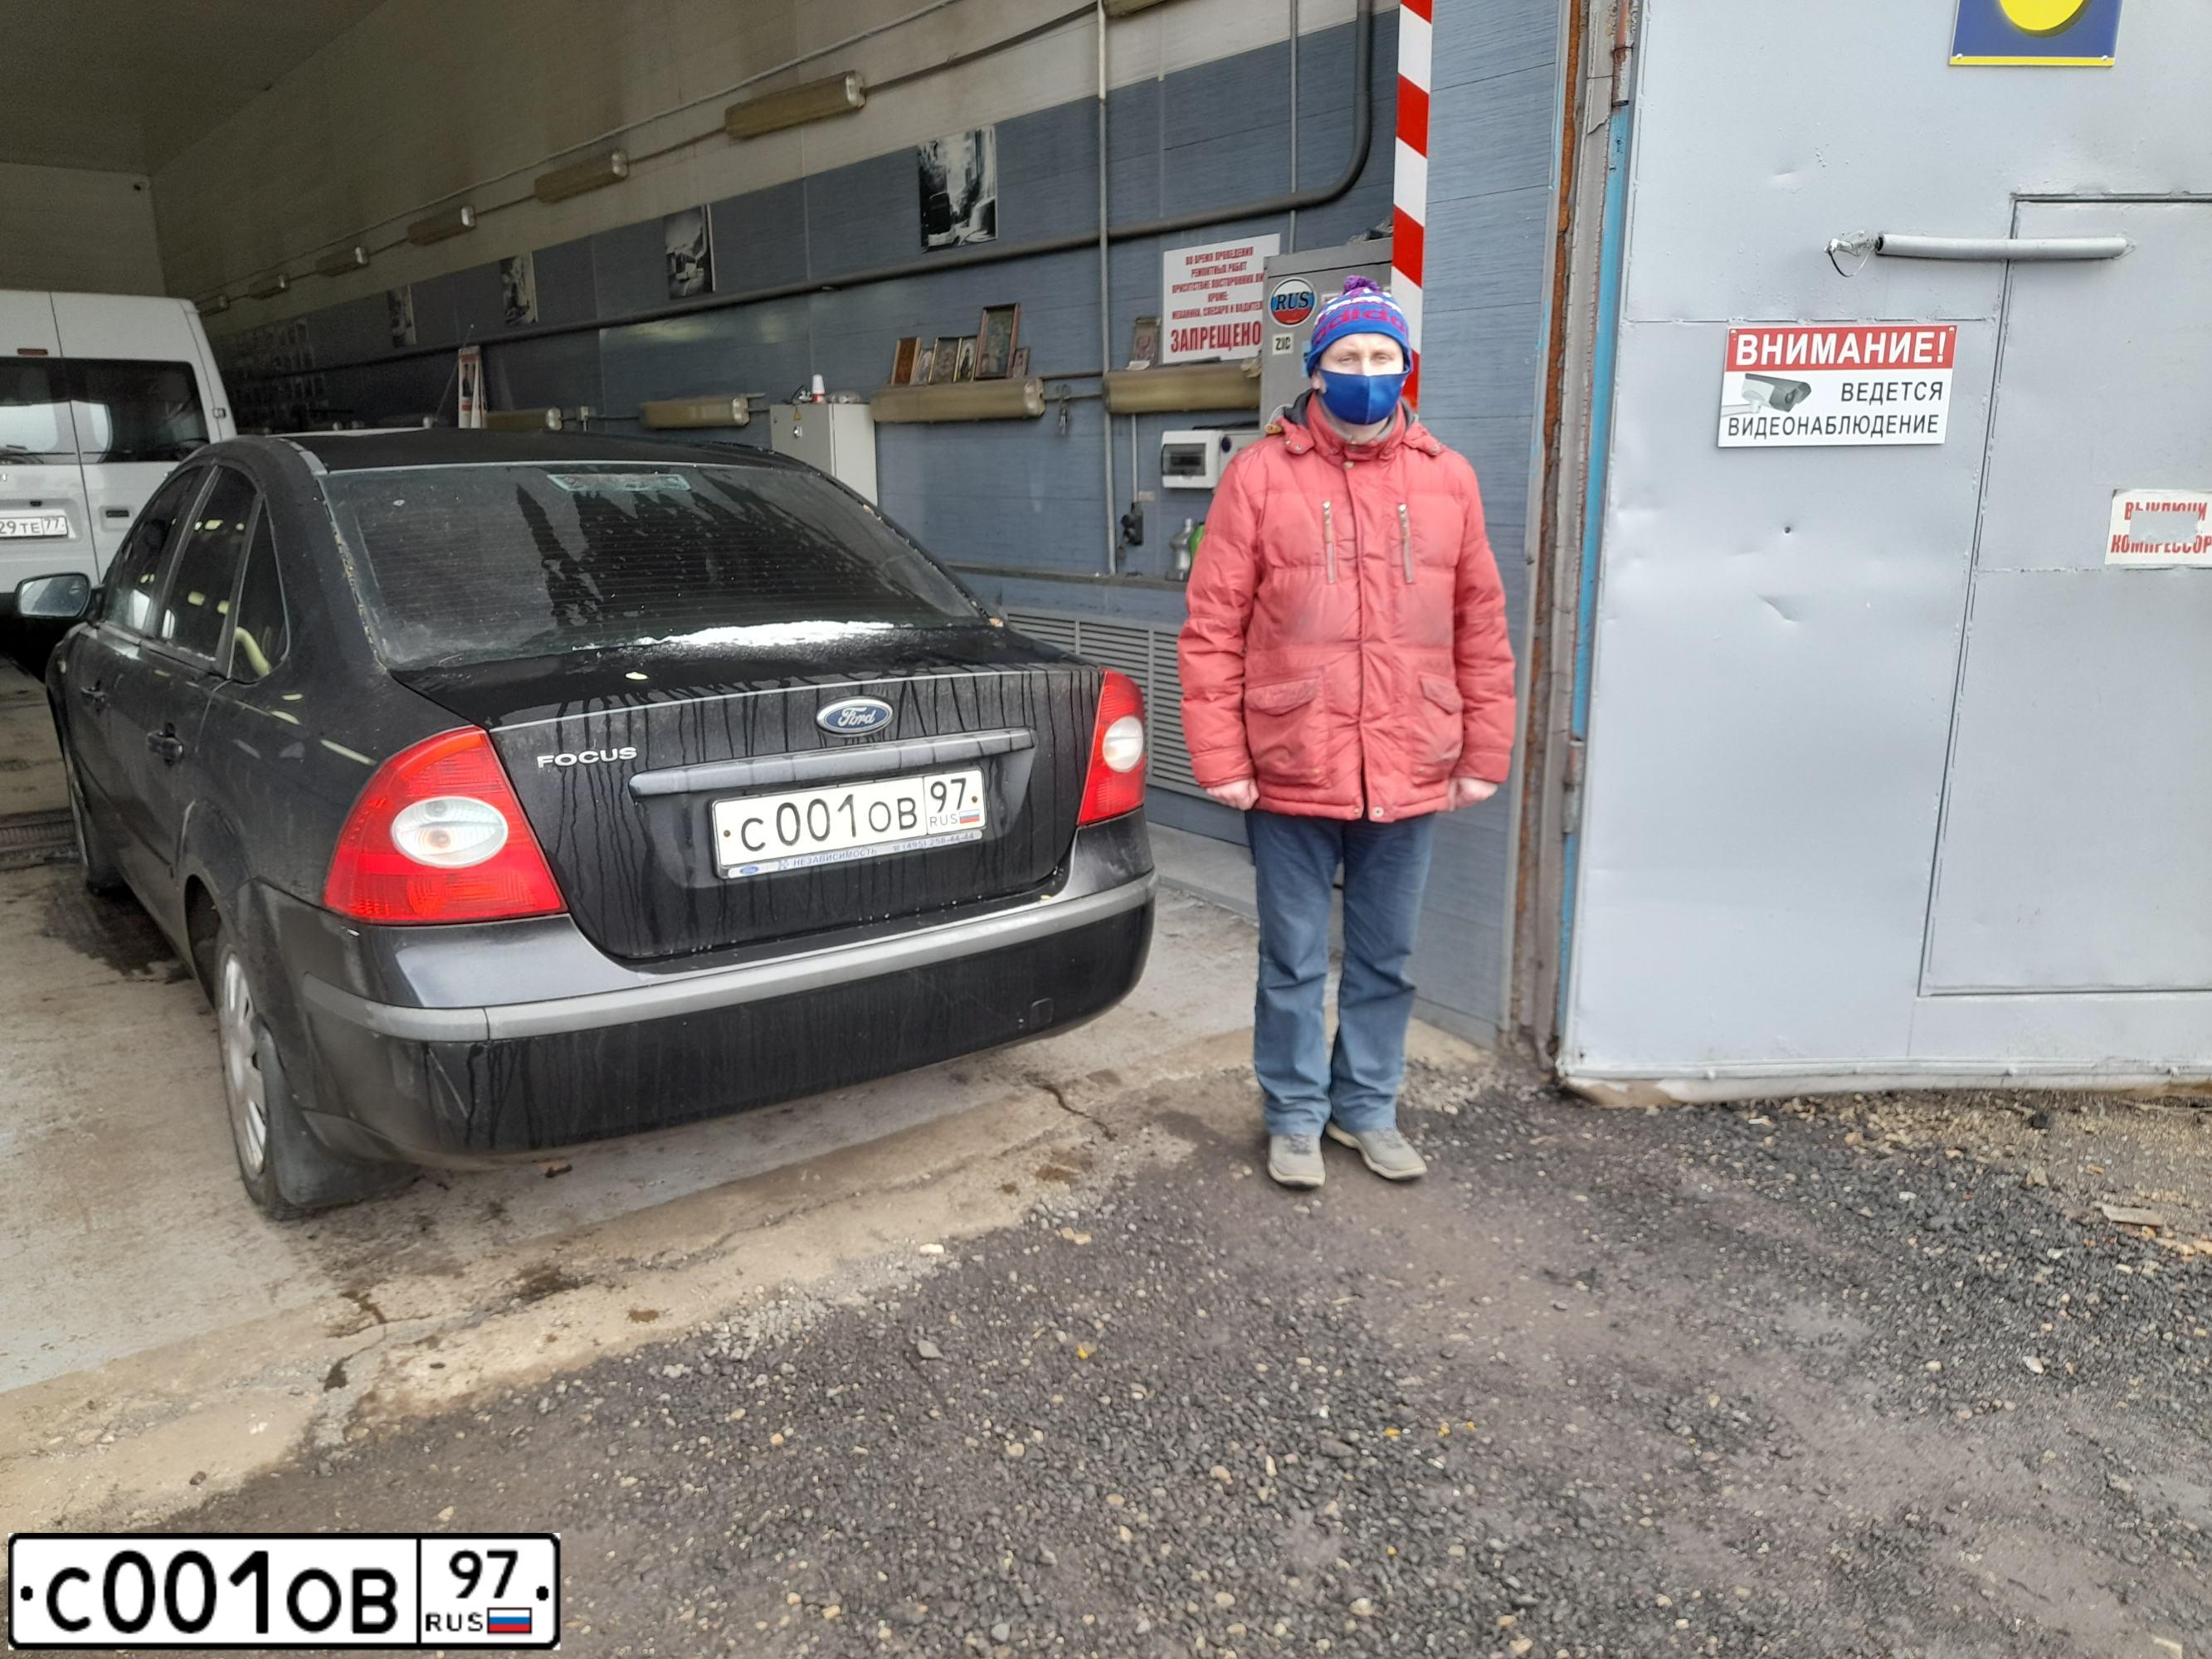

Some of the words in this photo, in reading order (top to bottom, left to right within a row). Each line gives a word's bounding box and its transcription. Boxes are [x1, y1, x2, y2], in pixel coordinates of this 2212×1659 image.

[1276, 290, 1308, 311] RUS
[1171, 321, 1261, 353] ЗАПРЕЩЕНО
[1315, 308, 1406, 345] adida
[1736, 331, 1946, 366] ВНИМАНИЕ!
[1841, 381, 1943, 406] ВЕДЕТСЯ
[1727, 415, 1939, 440] ВИДЕОНАБЛЮДЕНИЕ
[44, 518, 59, 530] 77
[837, 707, 878, 727] Ford
[537, 747, 638, 770] FOCUS
[930, 778, 967, 813] 97
[929, 814, 958, 828] RUS
